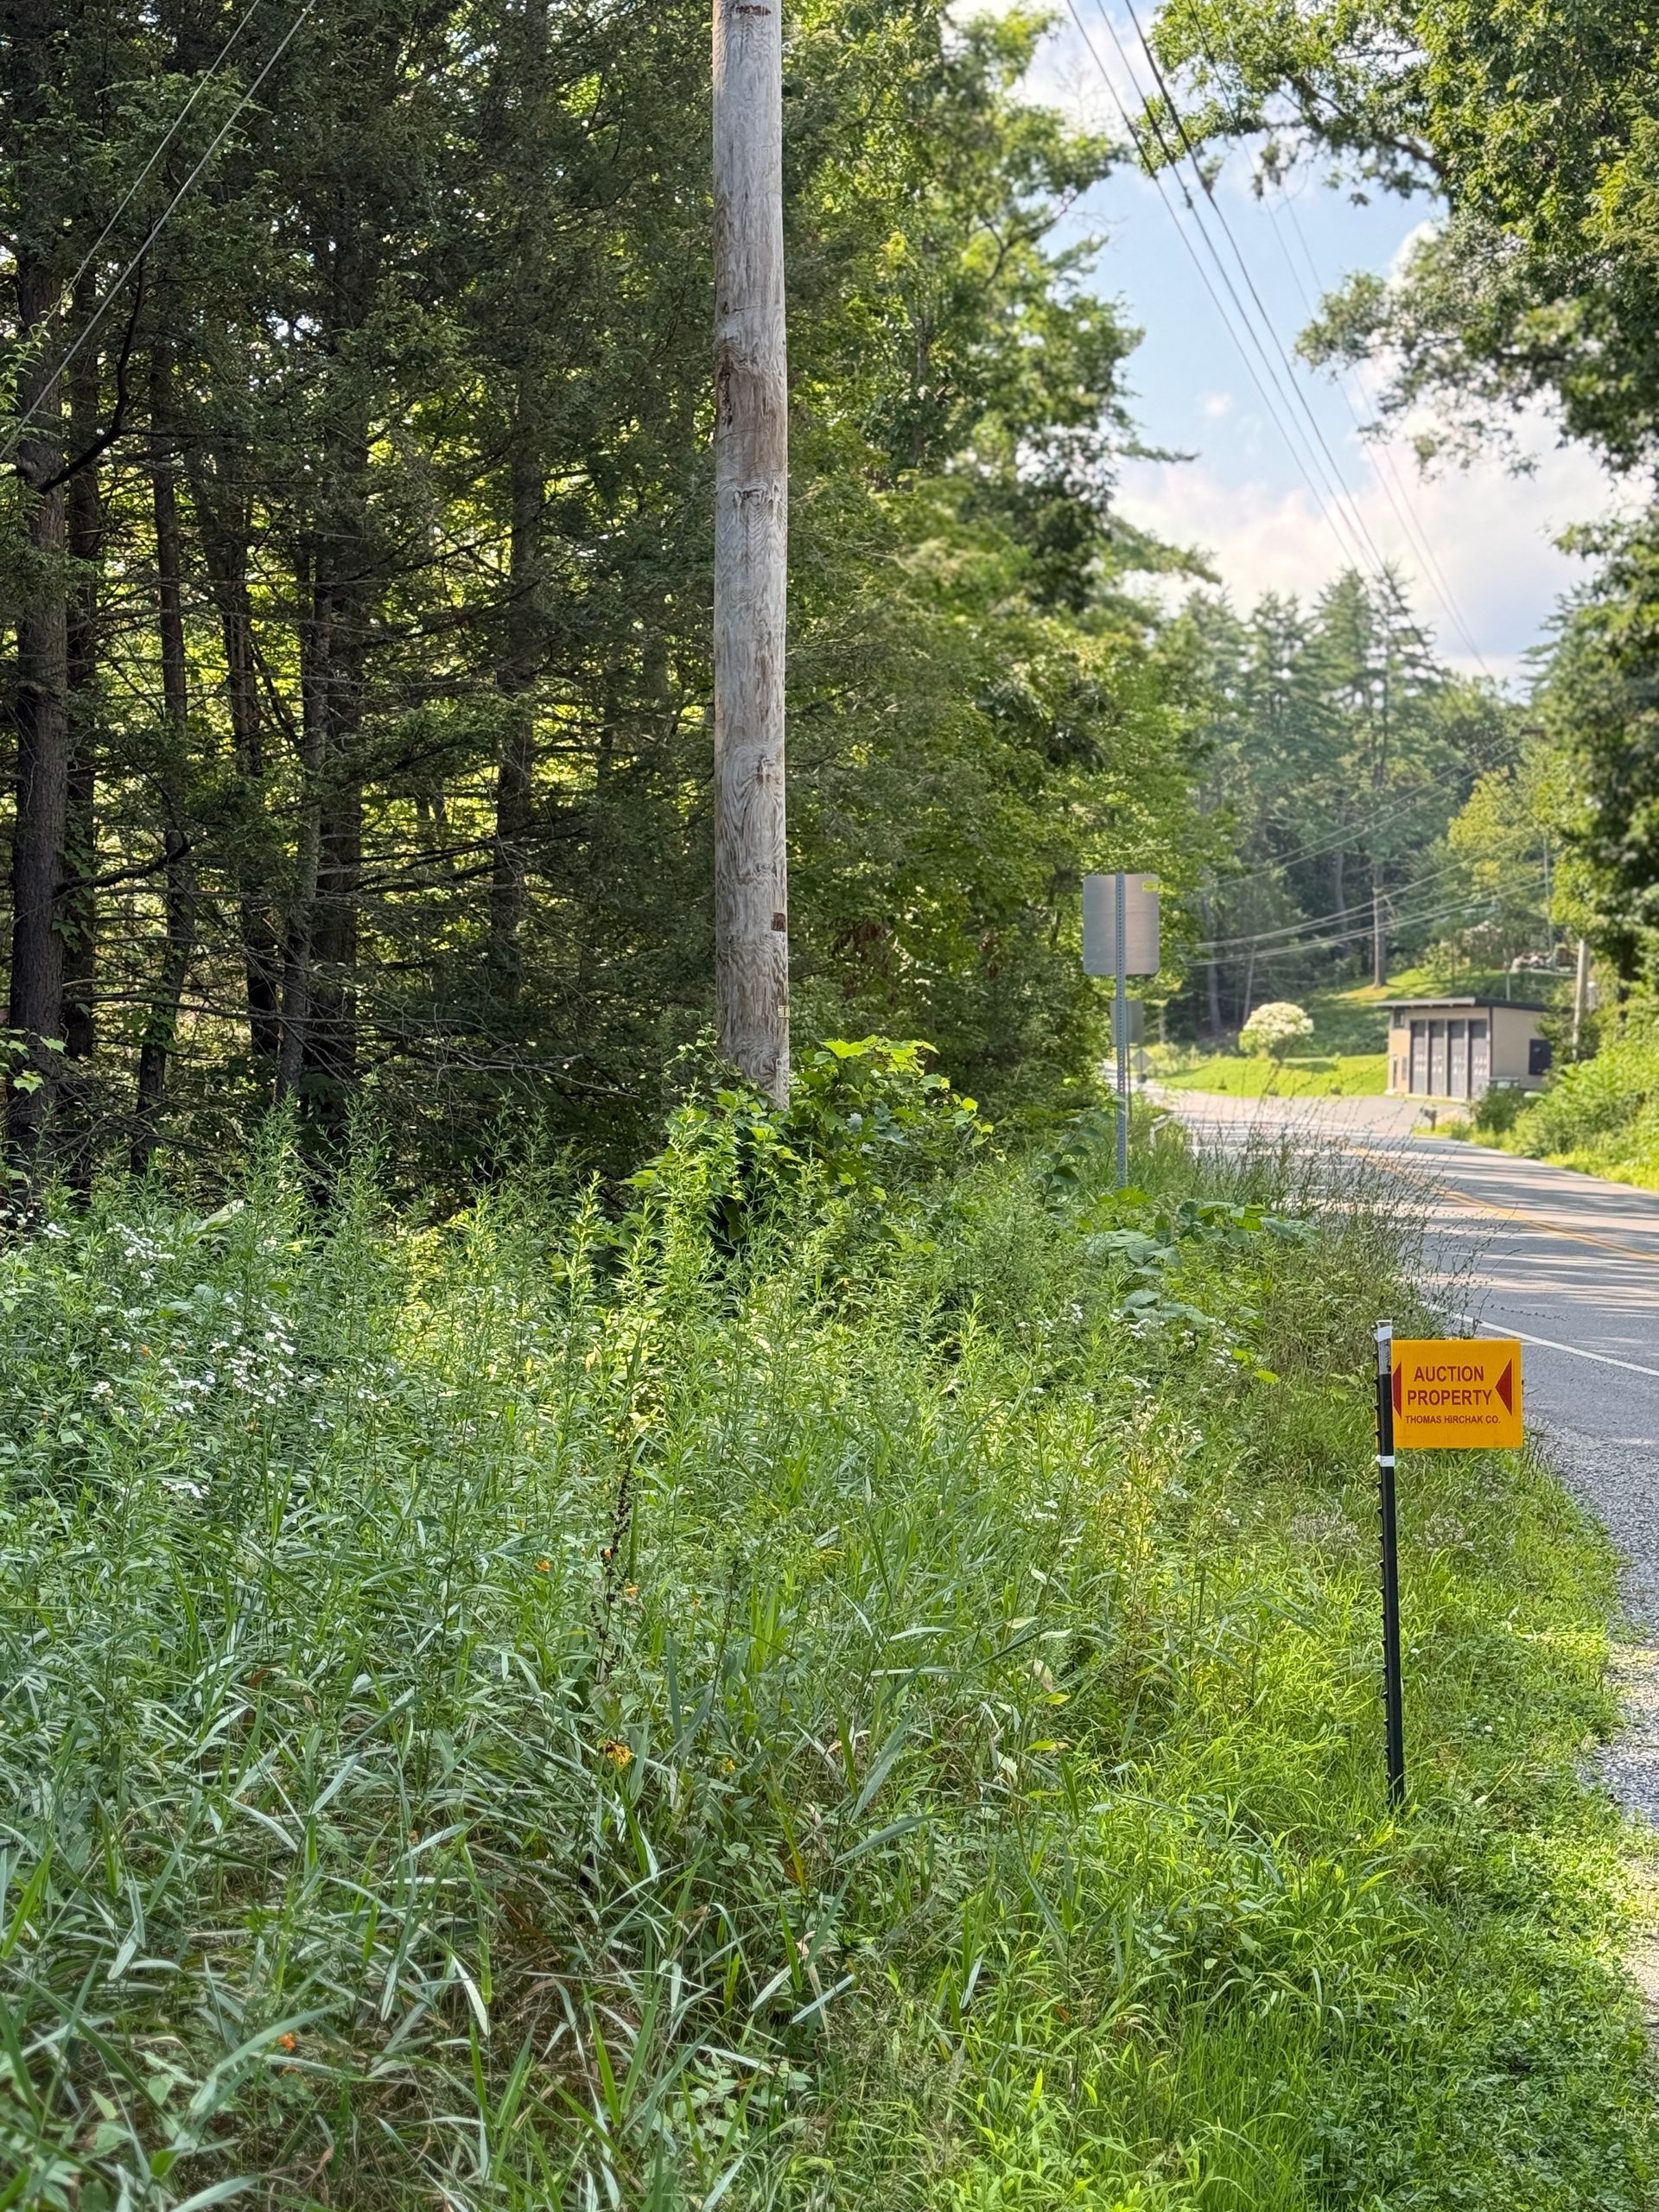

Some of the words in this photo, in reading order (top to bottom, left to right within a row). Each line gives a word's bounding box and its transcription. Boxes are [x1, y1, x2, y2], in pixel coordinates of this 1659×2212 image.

[1414, 1366, 1484, 1382] AUCTION
[1408, 1389, 1492, 1406] PROPERTY
[1406, 1415, 1442, 1424] THOMAS
[1445, 1415, 1484, 1424] HIRCHAK
[1485, 1415, 1501, 1424] CO.
